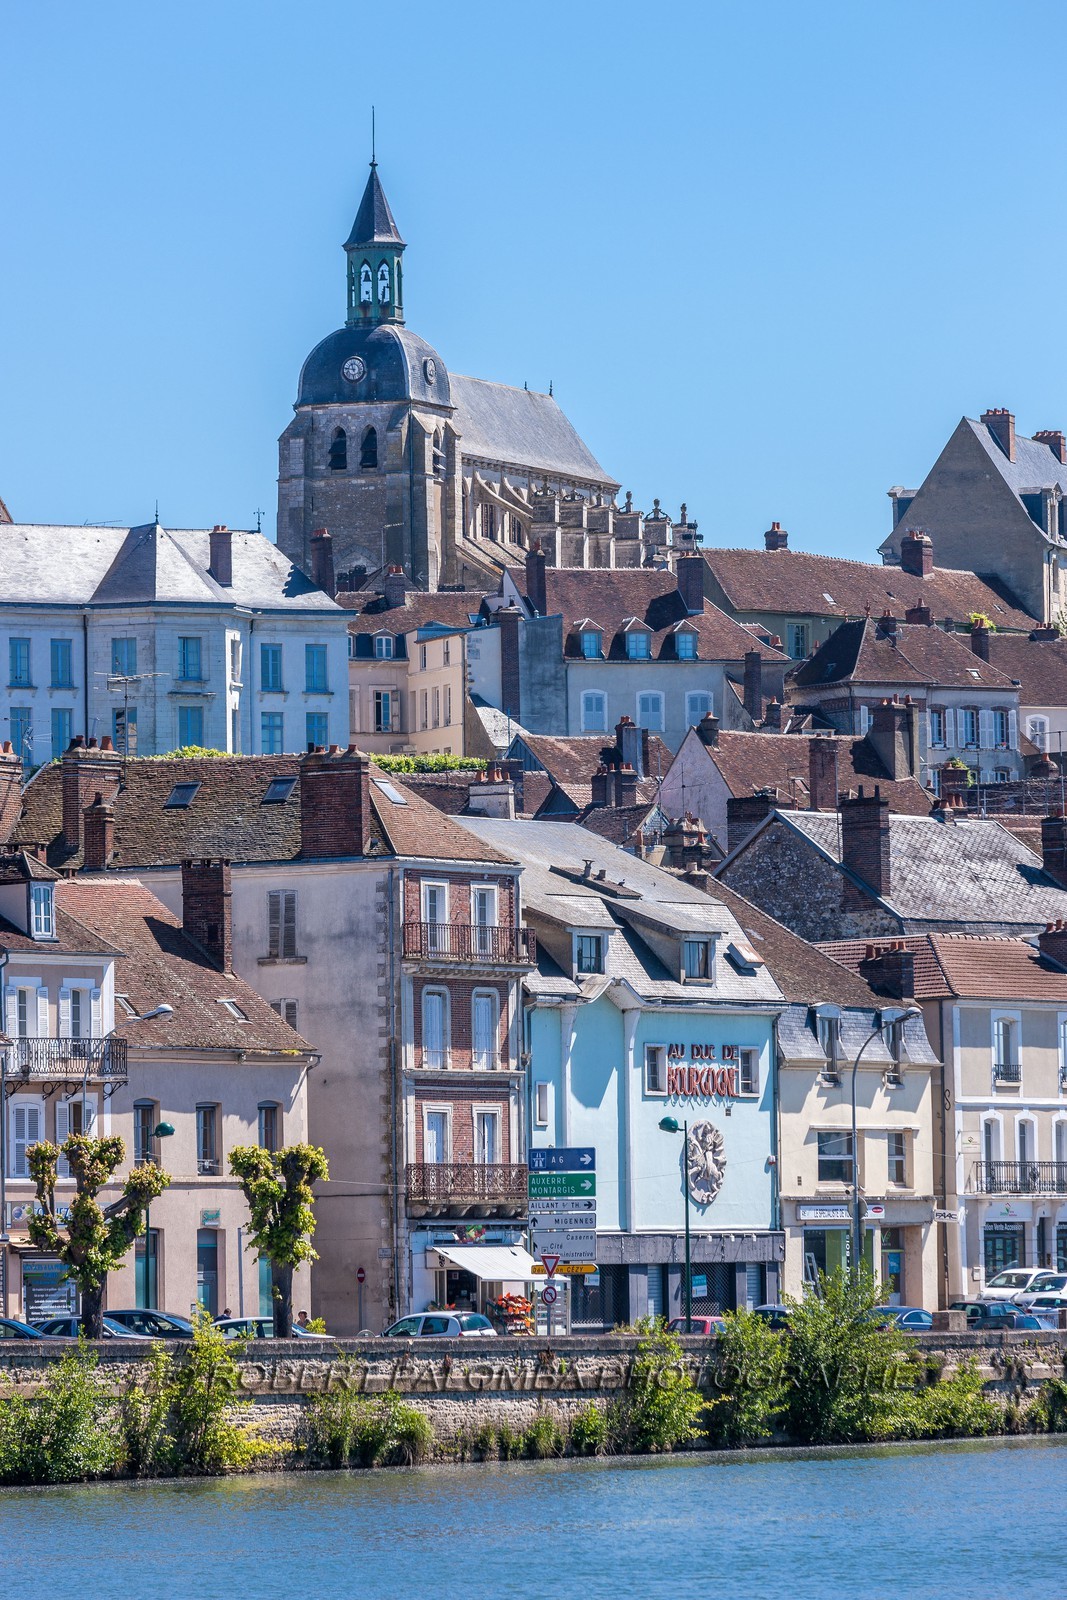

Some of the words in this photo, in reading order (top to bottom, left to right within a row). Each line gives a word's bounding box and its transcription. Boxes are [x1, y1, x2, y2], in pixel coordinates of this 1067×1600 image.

[667, 1043, 685, 1059] AU
[691, 1044, 717, 1060] DUC
[722, 1044, 739, 1060] DE
[667, 1067, 740, 1097] BOURGOGNE
[551, 1156, 556, 1164] A
[558, 1156, 564, 1164] 6
[531, 1177, 567, 1185] AUXERRE
[531, 1186, 576, 1194] MONTARGIS
[566, 1265, 584, 1273] CÉZY
